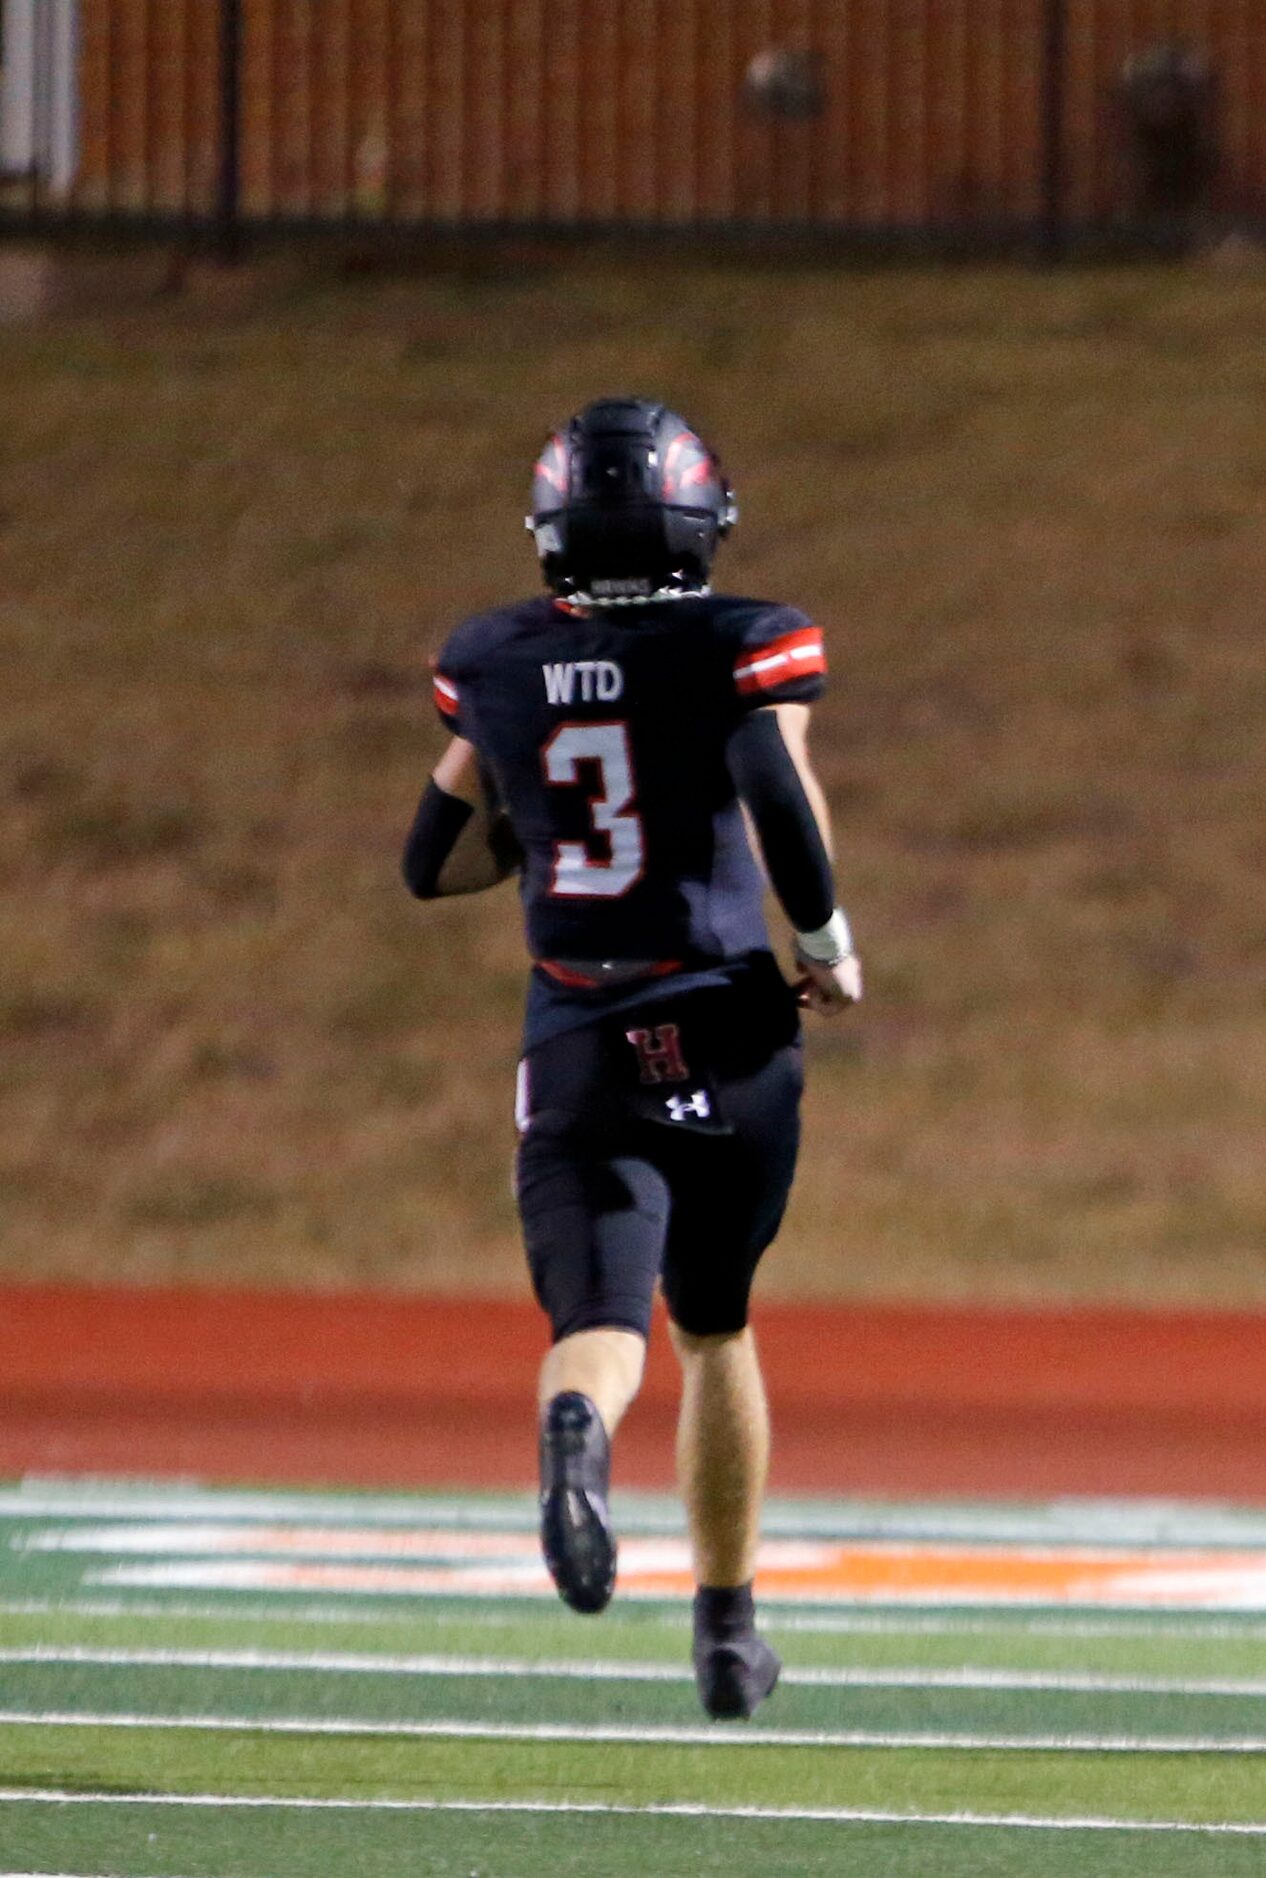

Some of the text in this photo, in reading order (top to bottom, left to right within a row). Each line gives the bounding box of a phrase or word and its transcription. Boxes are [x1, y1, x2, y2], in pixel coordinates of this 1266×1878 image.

[542, 661, 624, 705] WTD
[540, 720, 649, 899] 3
[625, 1023, 689, 1085] H
